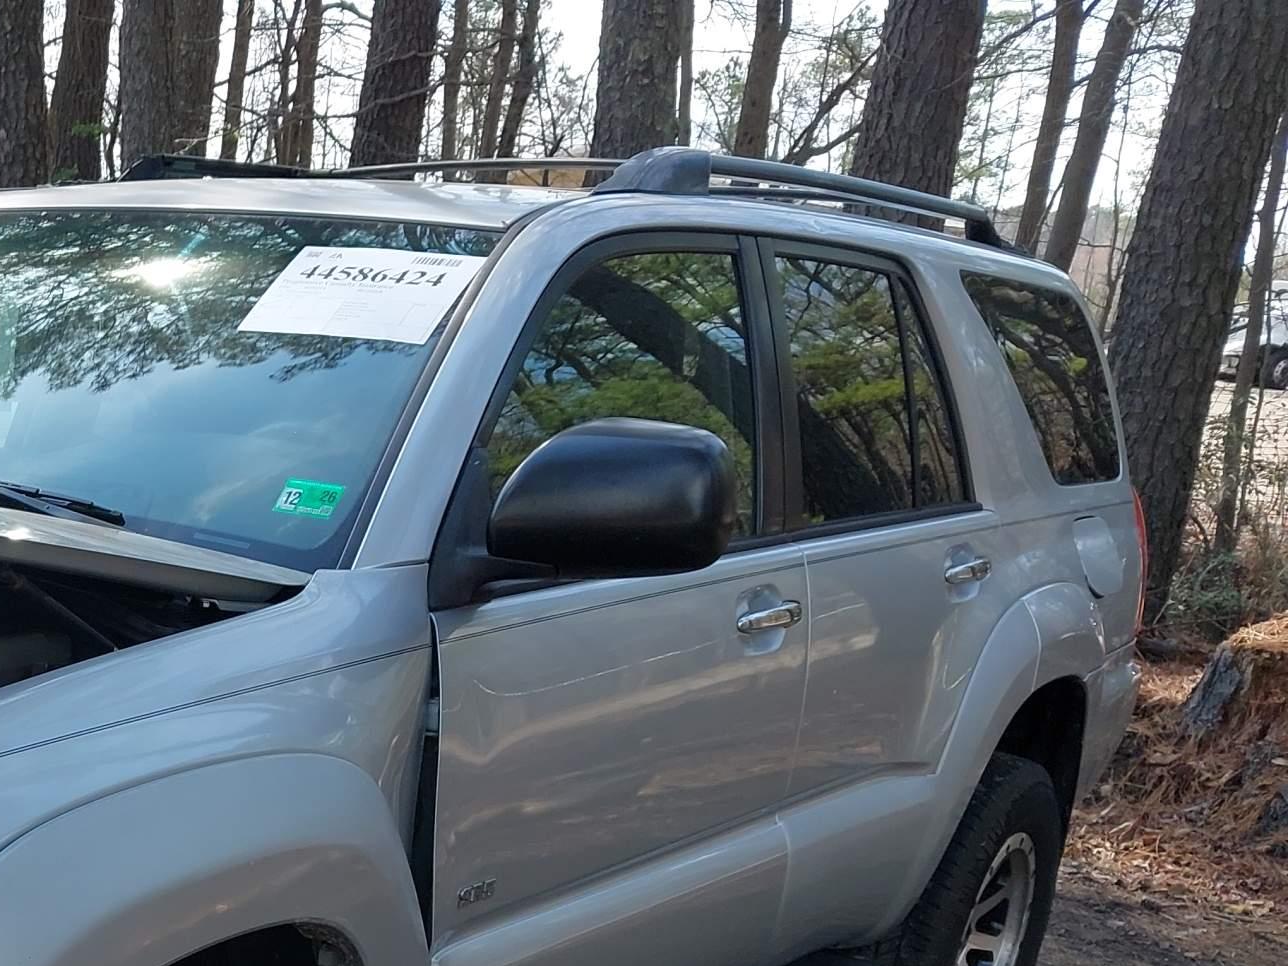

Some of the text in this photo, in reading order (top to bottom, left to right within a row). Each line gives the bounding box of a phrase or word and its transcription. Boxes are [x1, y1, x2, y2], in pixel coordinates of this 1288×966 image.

[300, 264, 447, 287] 44586424
[282, 490, 338, 506] 12 26
